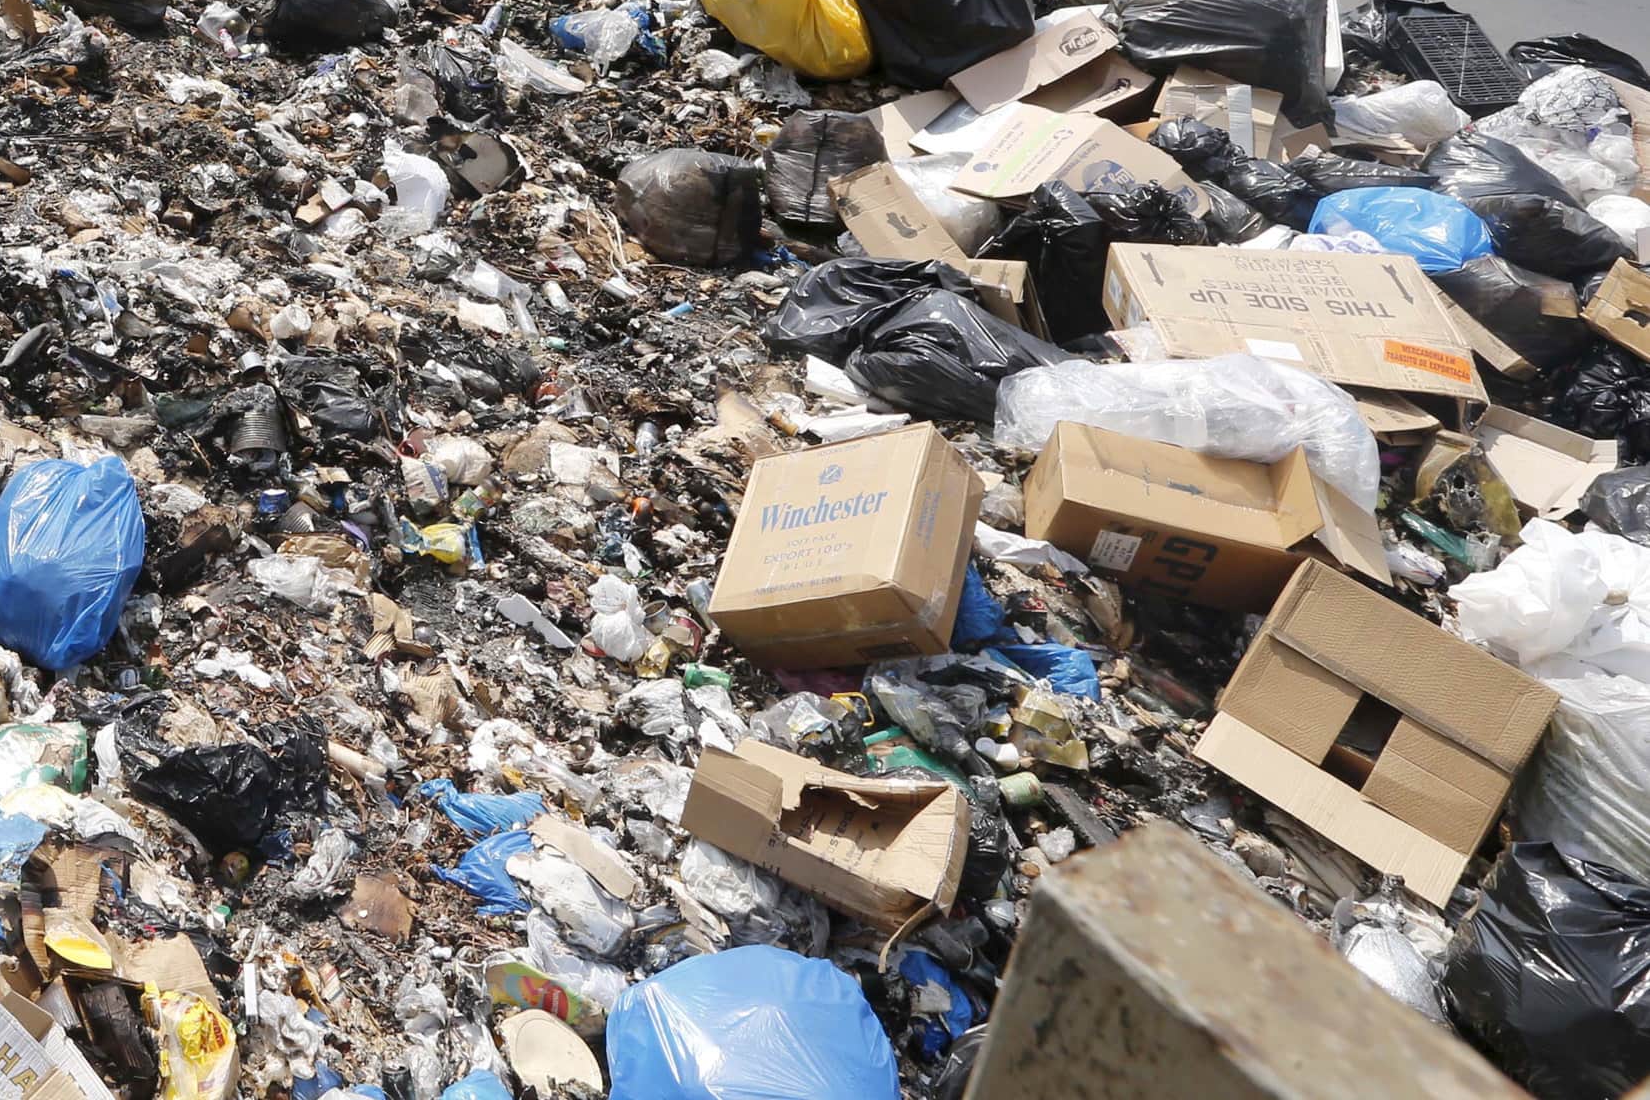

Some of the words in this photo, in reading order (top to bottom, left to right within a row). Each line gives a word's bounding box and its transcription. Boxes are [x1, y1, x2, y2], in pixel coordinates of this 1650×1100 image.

[1269, 273, 1348, 287] BEIRUT
[1189, 288, 1228, 305] UP
[1246, 293, 1310, 313] SIDE
[1326, 300, 1397, 318] THIS
[760, 490, 889, 535] Winchester
[812, 532, 838, 543] PACK
[763, 547, 815, 565] EXPORT
[753, 580, 804, 597] AMERICAN
